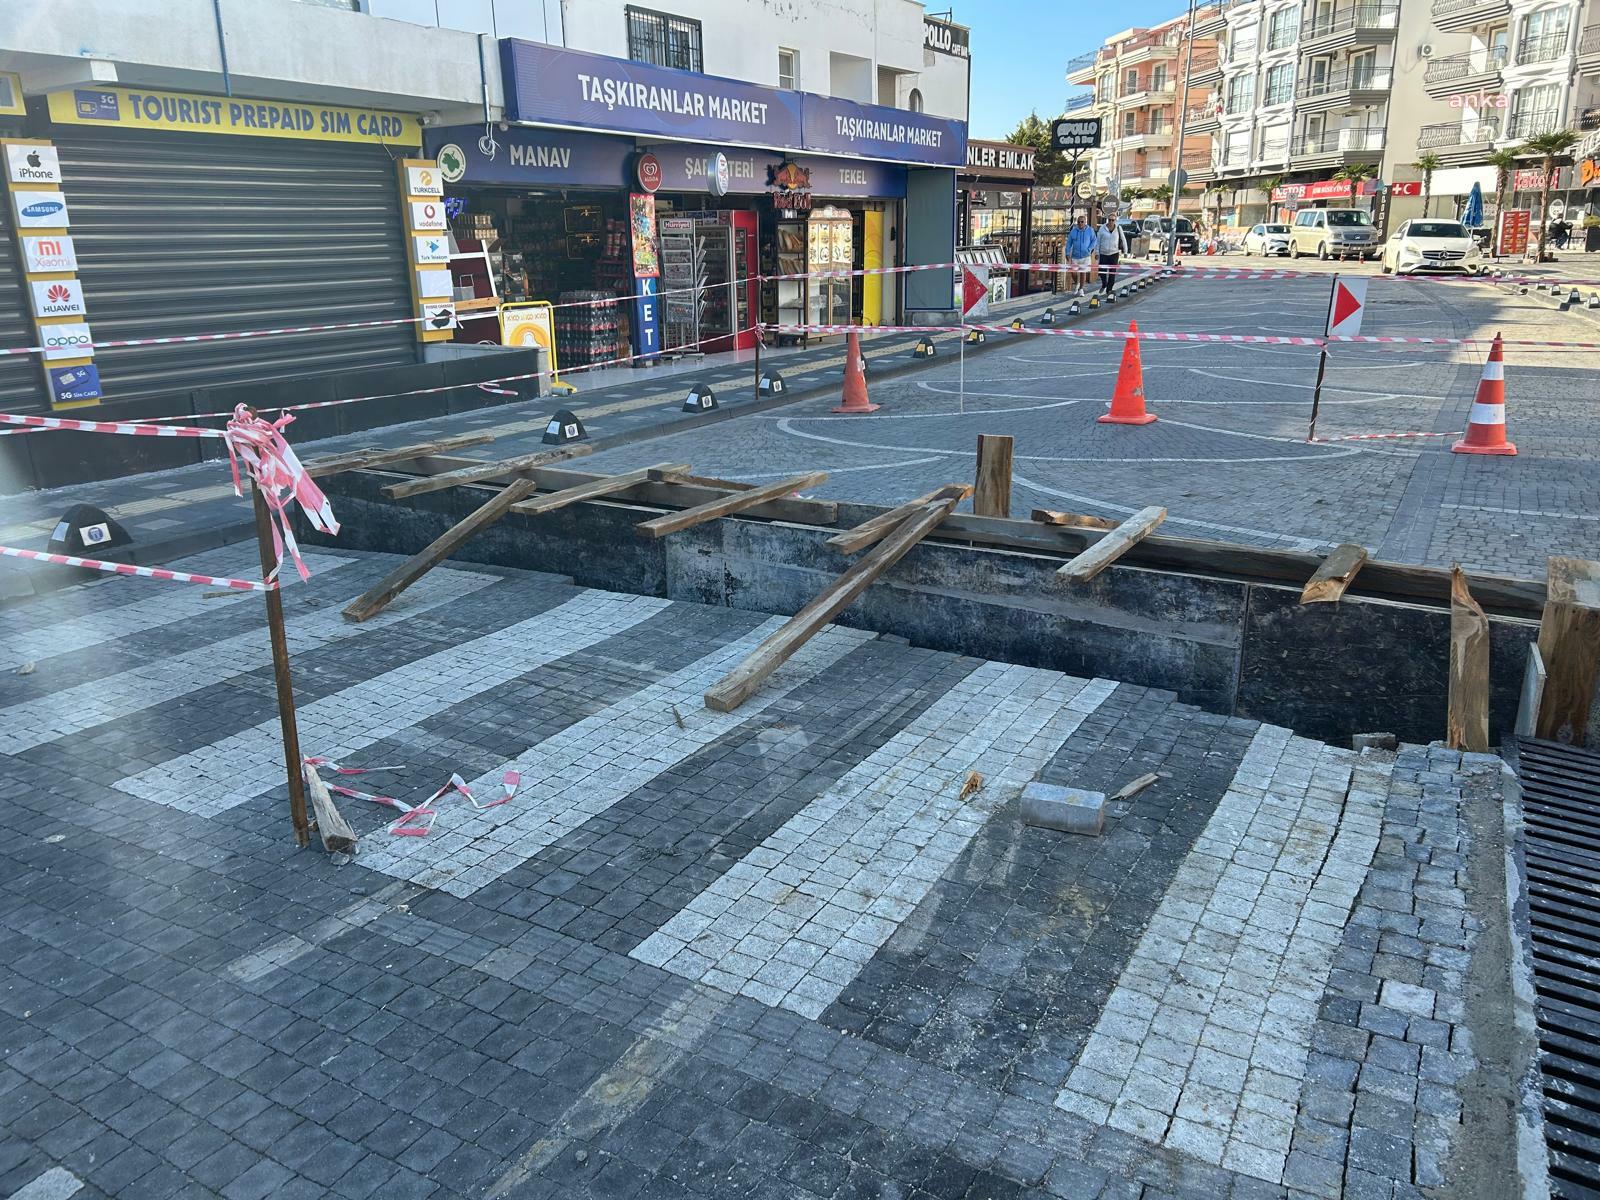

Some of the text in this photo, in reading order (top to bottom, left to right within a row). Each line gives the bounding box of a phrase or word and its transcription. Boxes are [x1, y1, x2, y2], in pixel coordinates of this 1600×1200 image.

[101, 95, 115, 104] 5G
[577, 74, 768, 125] TAŞKIRANLAR MARKET
[128, 94, 403, 138] TOURIST PREPAID SIM CARD
[835, 115, 942, 148] TAŞKIRANLAR MARKET
[1057, 122, 1098, 137] APOLLO
[509, 144, 571, 169] MANAV
[966, 146, 1035, 171] NLER EMLAK
[19, 168, 54, 179] iPhone
[685, 157, 755, 180] ŞATERİ
[839, 168, 867, 185] TEKEL
[773, 191, 793, 209] Red
[35, 256, 70, 267] Xiaomi
[43, 304, 80, 313] HUAWEI
